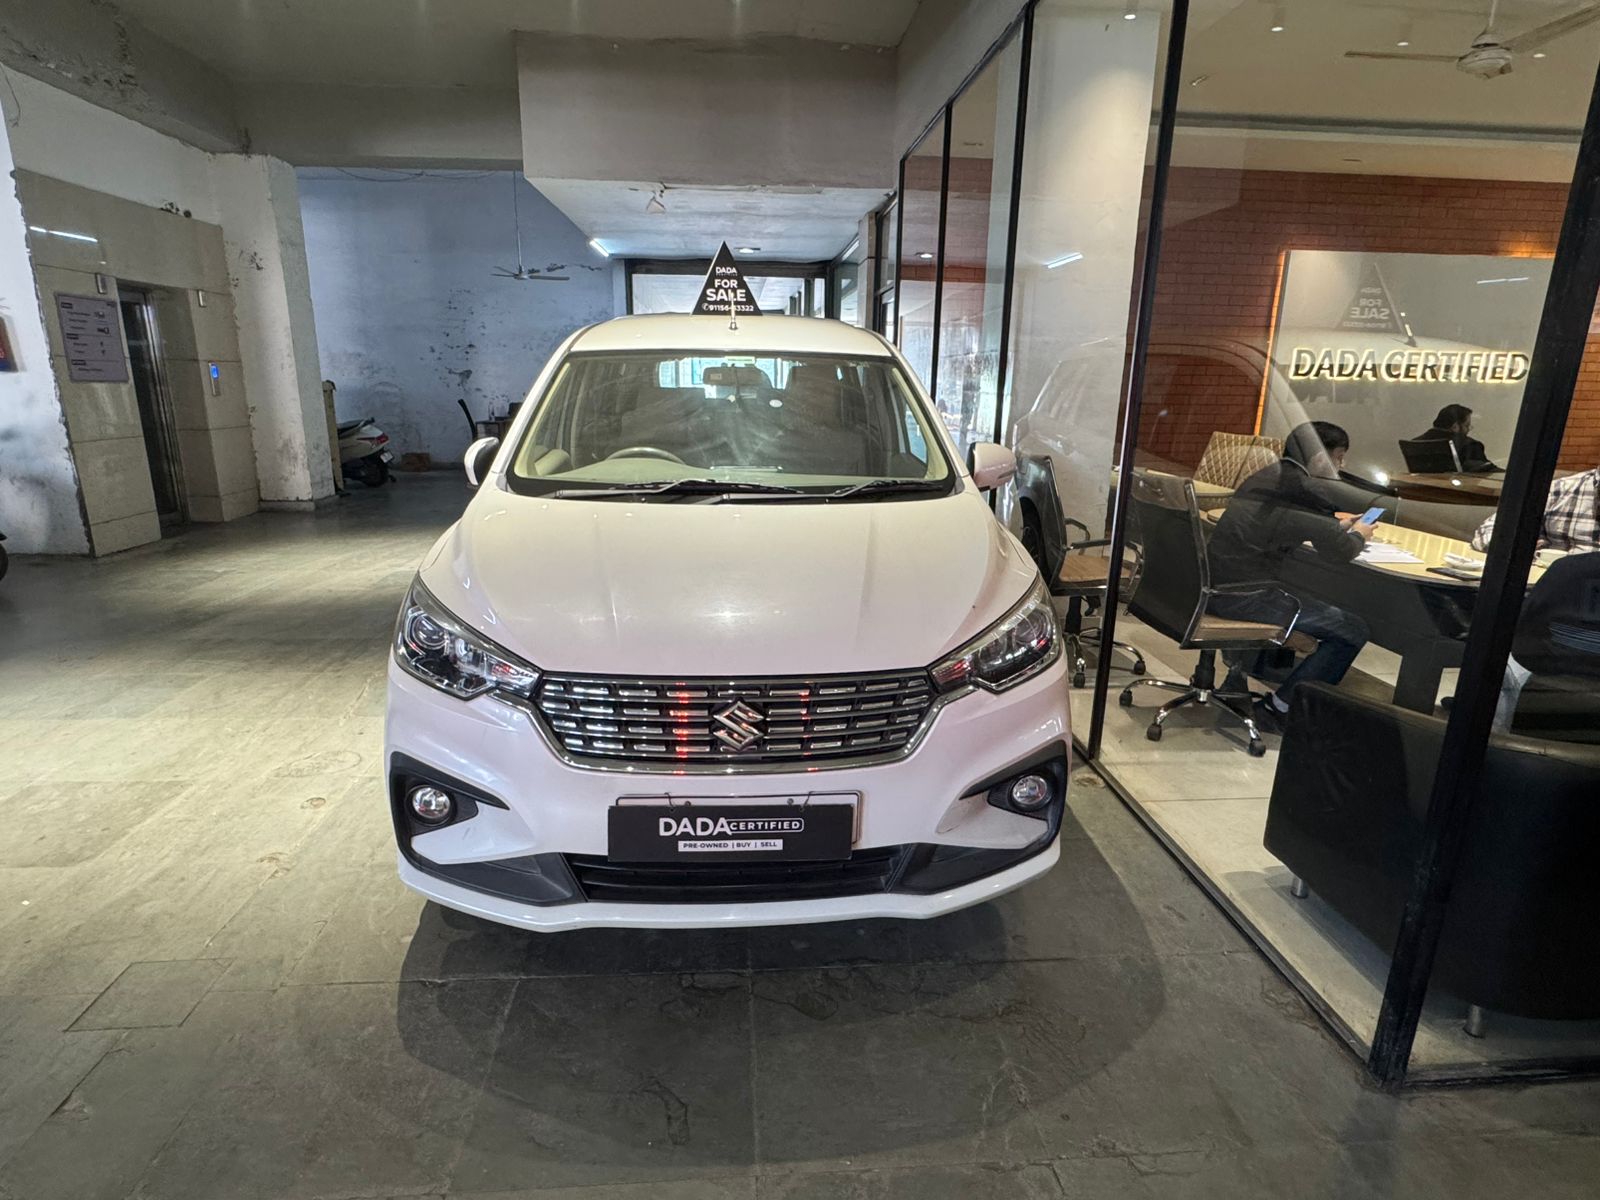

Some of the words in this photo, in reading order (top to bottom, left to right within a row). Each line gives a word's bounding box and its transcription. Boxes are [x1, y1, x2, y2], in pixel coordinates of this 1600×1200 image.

[715, 266, 737, 274] DADA
[714, 279, 738, 288] FOR
[706, 288, 746, 302] SALE
[1290, 348, 1378, 381] DADA
[1381, 350, 1529, 383] CERTIFIED
[659, 817, 732, 836] DADA
[729, 821, 800, 830] CERTIFIED
